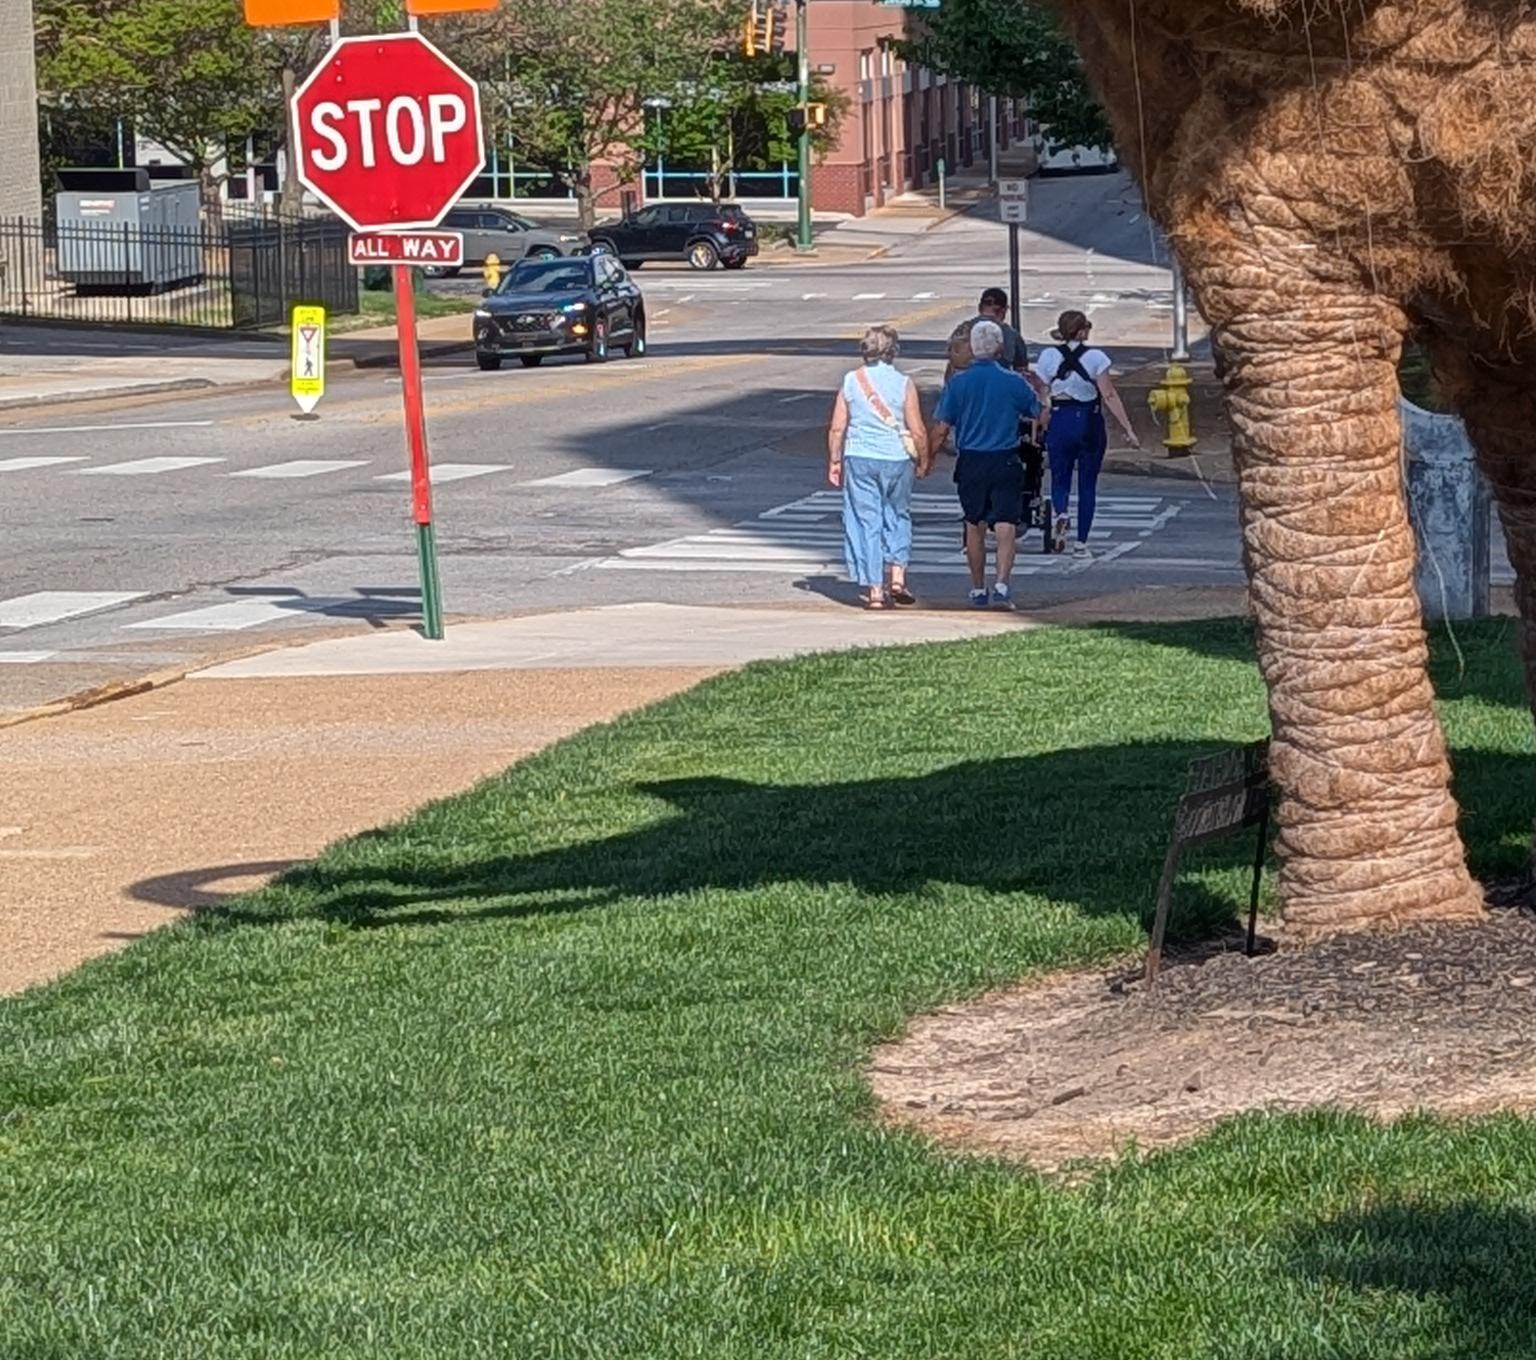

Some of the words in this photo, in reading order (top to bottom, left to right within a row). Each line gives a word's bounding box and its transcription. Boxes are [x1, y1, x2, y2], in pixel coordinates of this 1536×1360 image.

[310, 93, 467, 172] STOP
[353, 238, 389, 257] ALL
[402, 238, 456, 258] WAY
